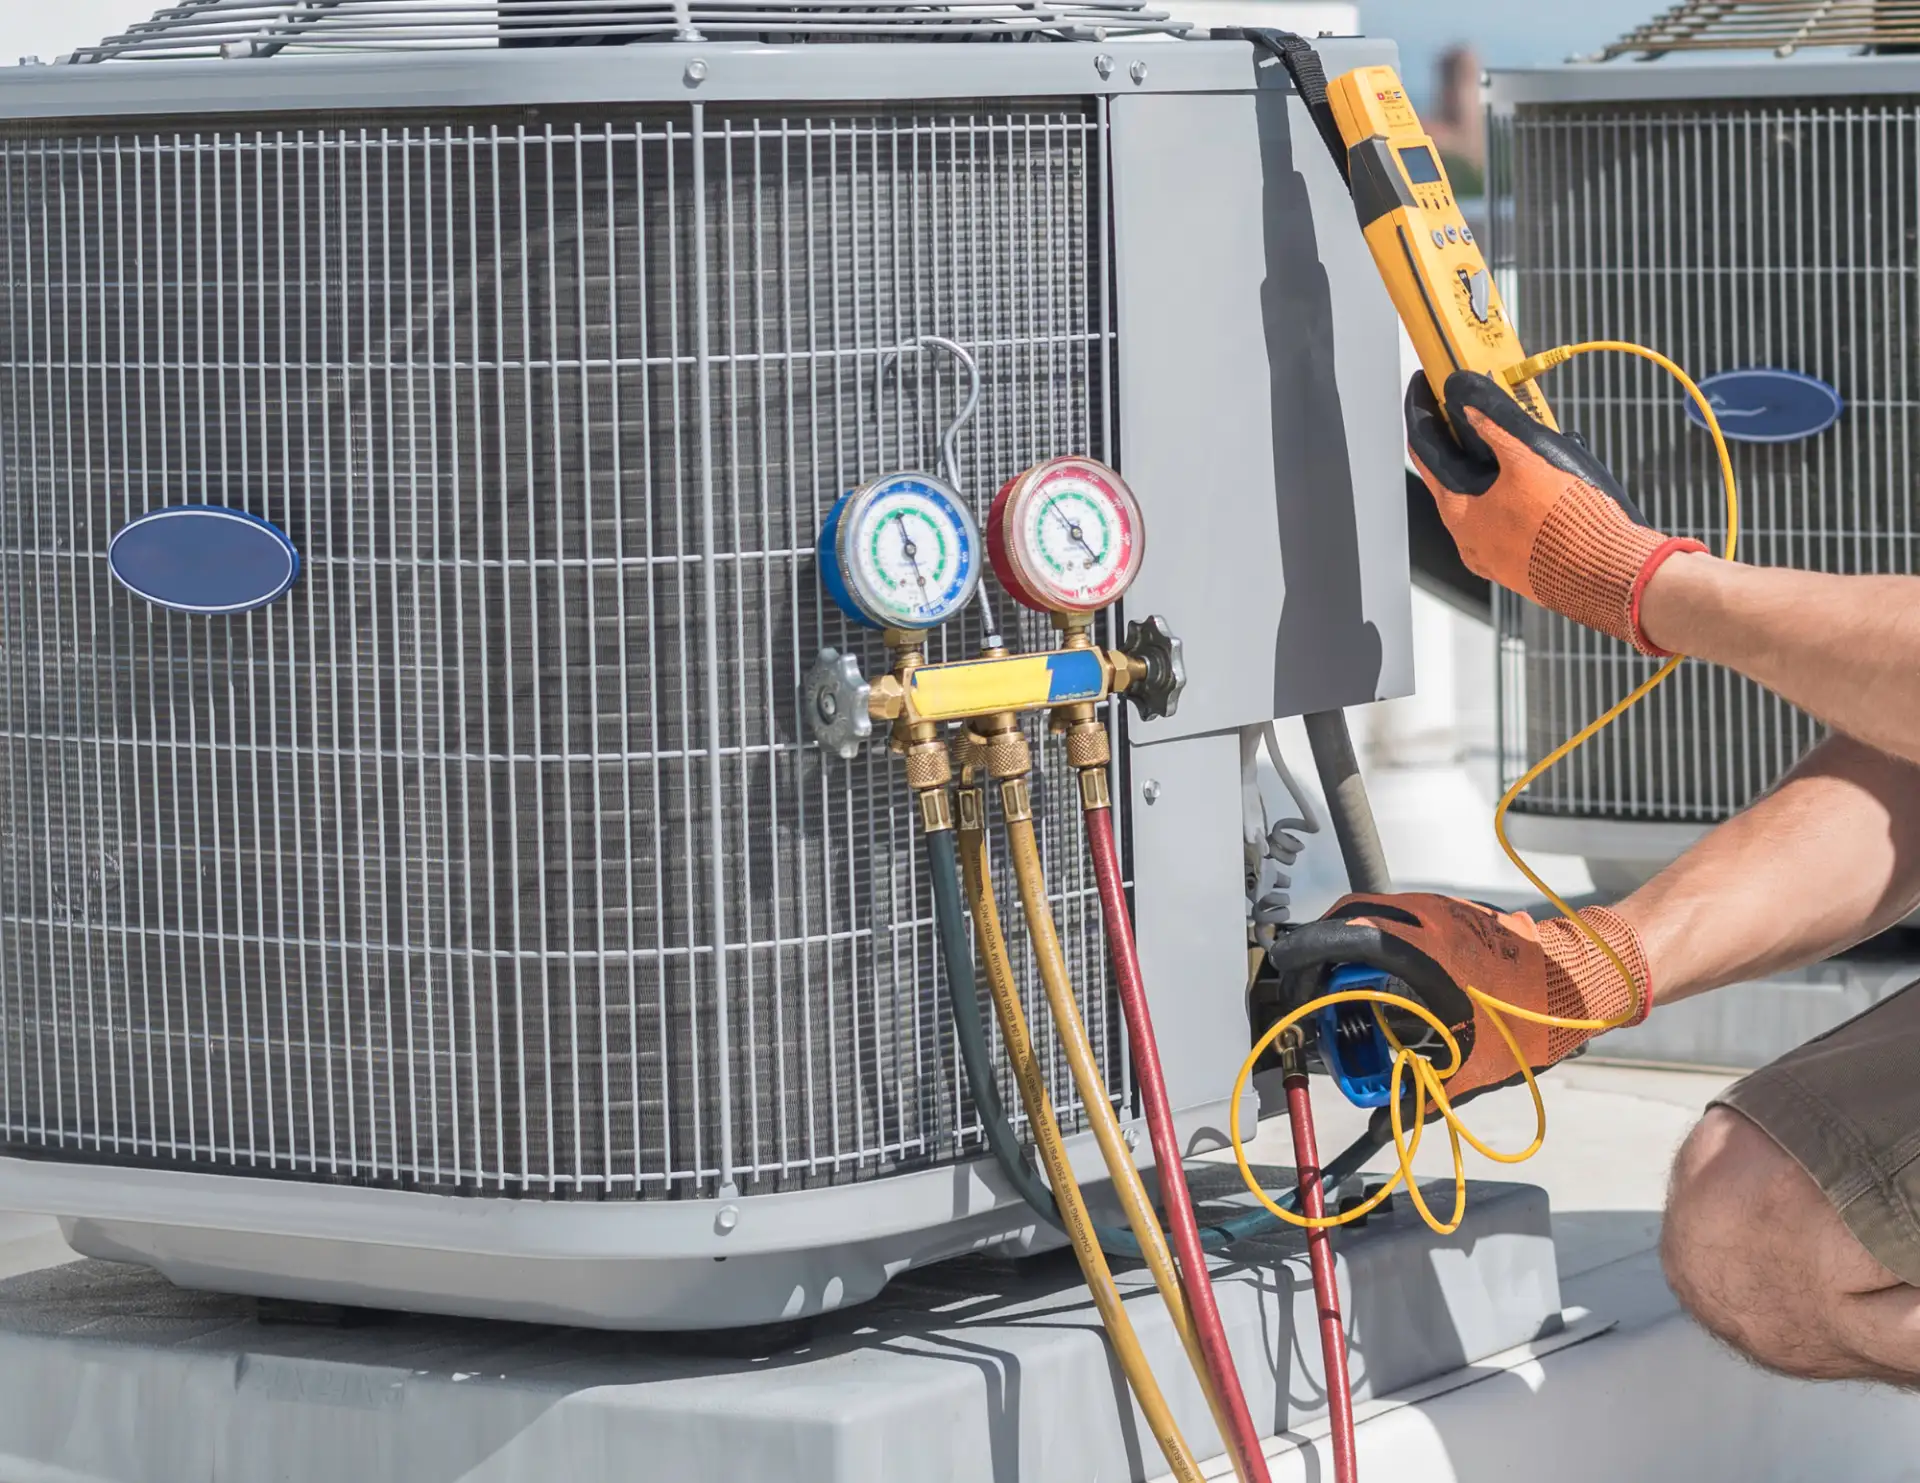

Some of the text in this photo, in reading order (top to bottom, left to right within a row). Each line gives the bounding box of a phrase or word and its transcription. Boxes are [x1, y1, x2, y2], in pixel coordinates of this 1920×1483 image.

[980, 903, 997, 951] WORKING
[991, 952, 1009, 998] MAXIMUM
[1070, 1207, 1092, 1253] CHARGING
